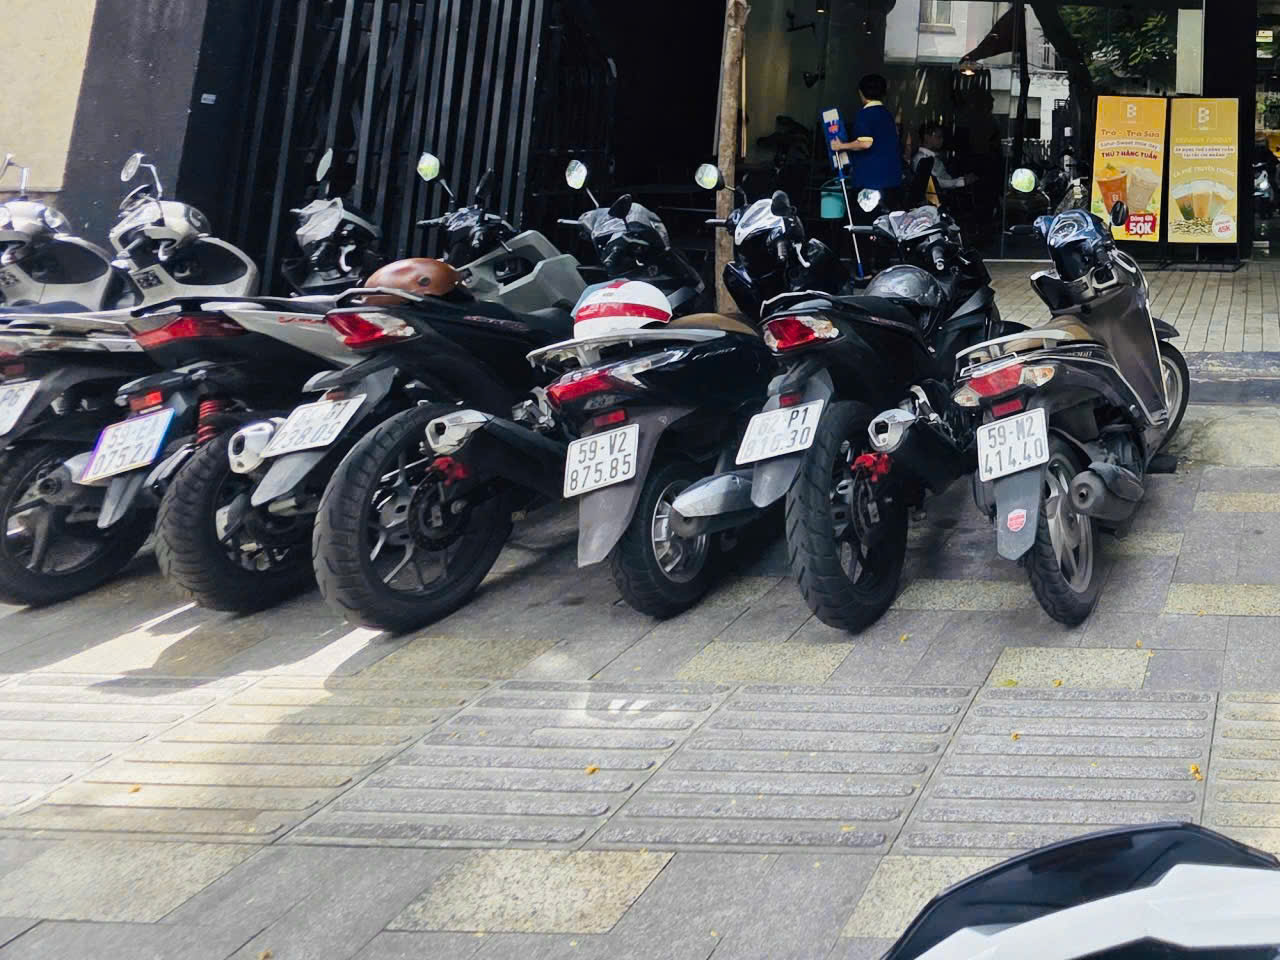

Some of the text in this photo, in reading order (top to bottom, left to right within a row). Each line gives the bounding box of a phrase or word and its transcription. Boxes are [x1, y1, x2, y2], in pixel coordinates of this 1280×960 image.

[1129, 222, 1153, 234] 50K
[578, 431, 627, 464] 59-V2
[984, 437, 1044, 475] 414.40
[570, 453, 631, 491] 875.85
